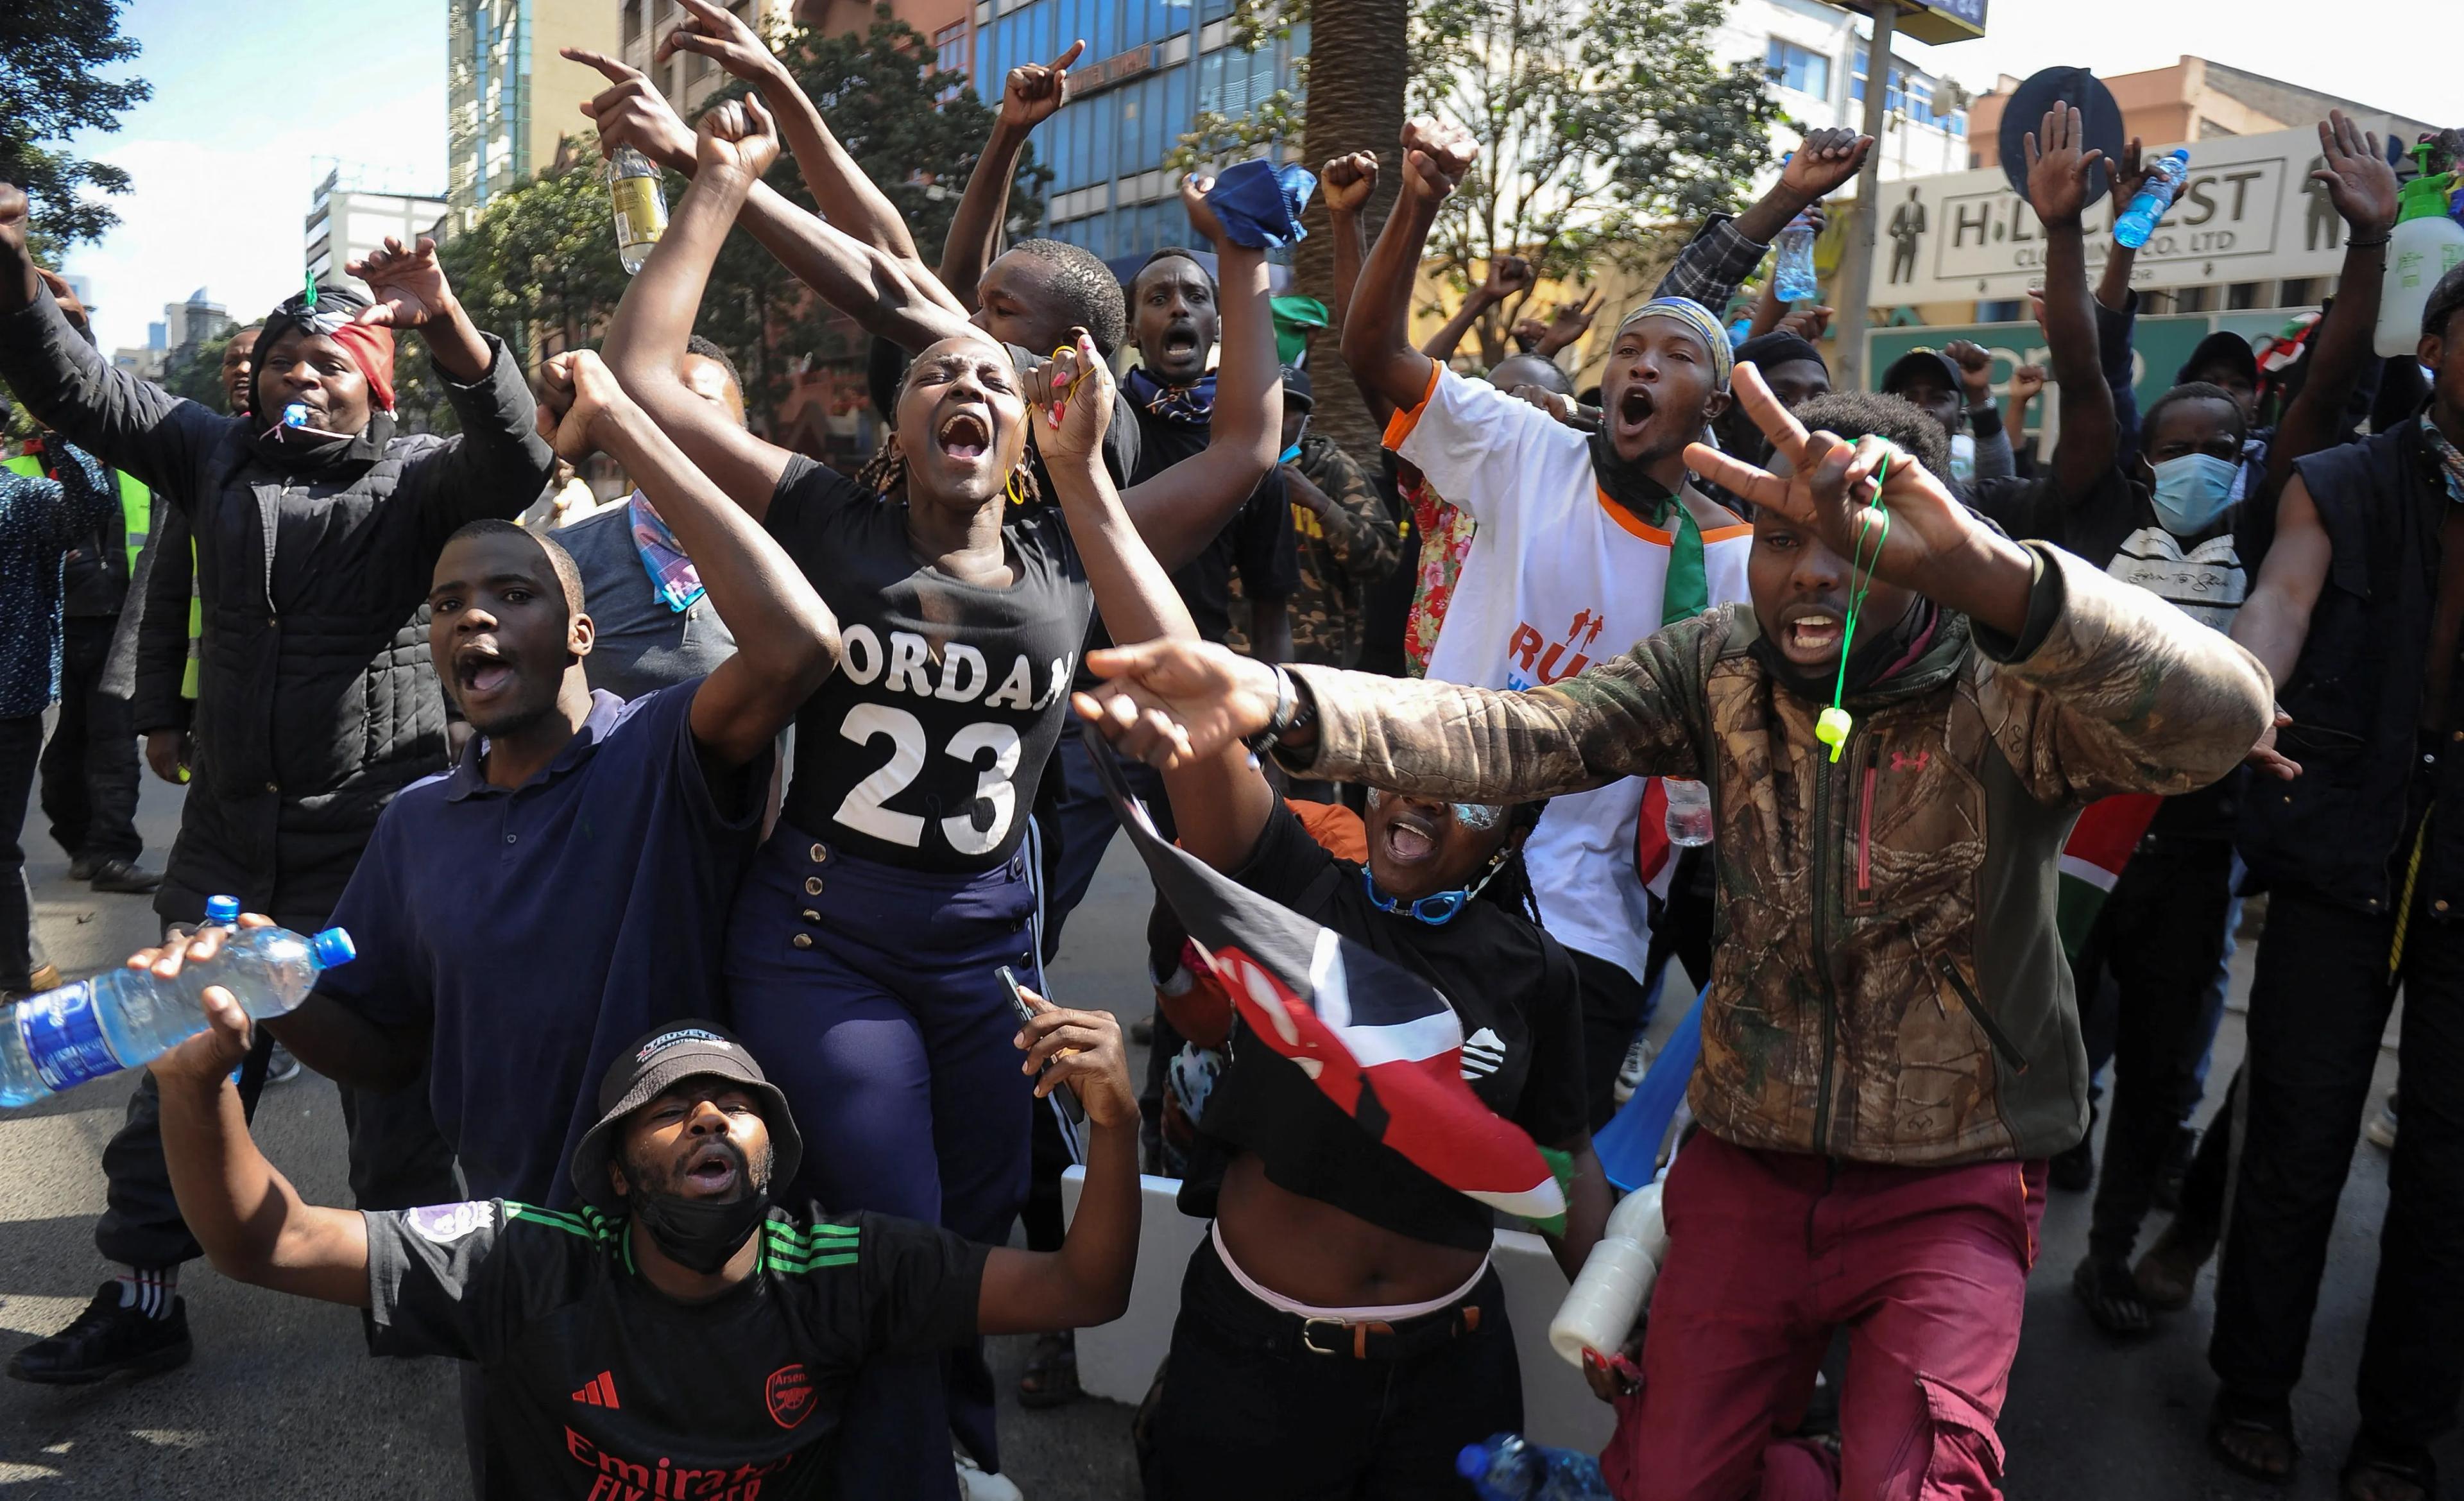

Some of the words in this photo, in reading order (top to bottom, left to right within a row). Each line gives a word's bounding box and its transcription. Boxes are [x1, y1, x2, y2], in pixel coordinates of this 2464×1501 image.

[2190, 230, 2234, 251] LTD
[840, 624, 1074, 712] ORDAN
[1509, 620, 1604, 685] RU
[832, 703, 1021, 855] 23
[775, 1373, 809, 1385] Arsen
[564, 1425, 792, 1500] Emirat
